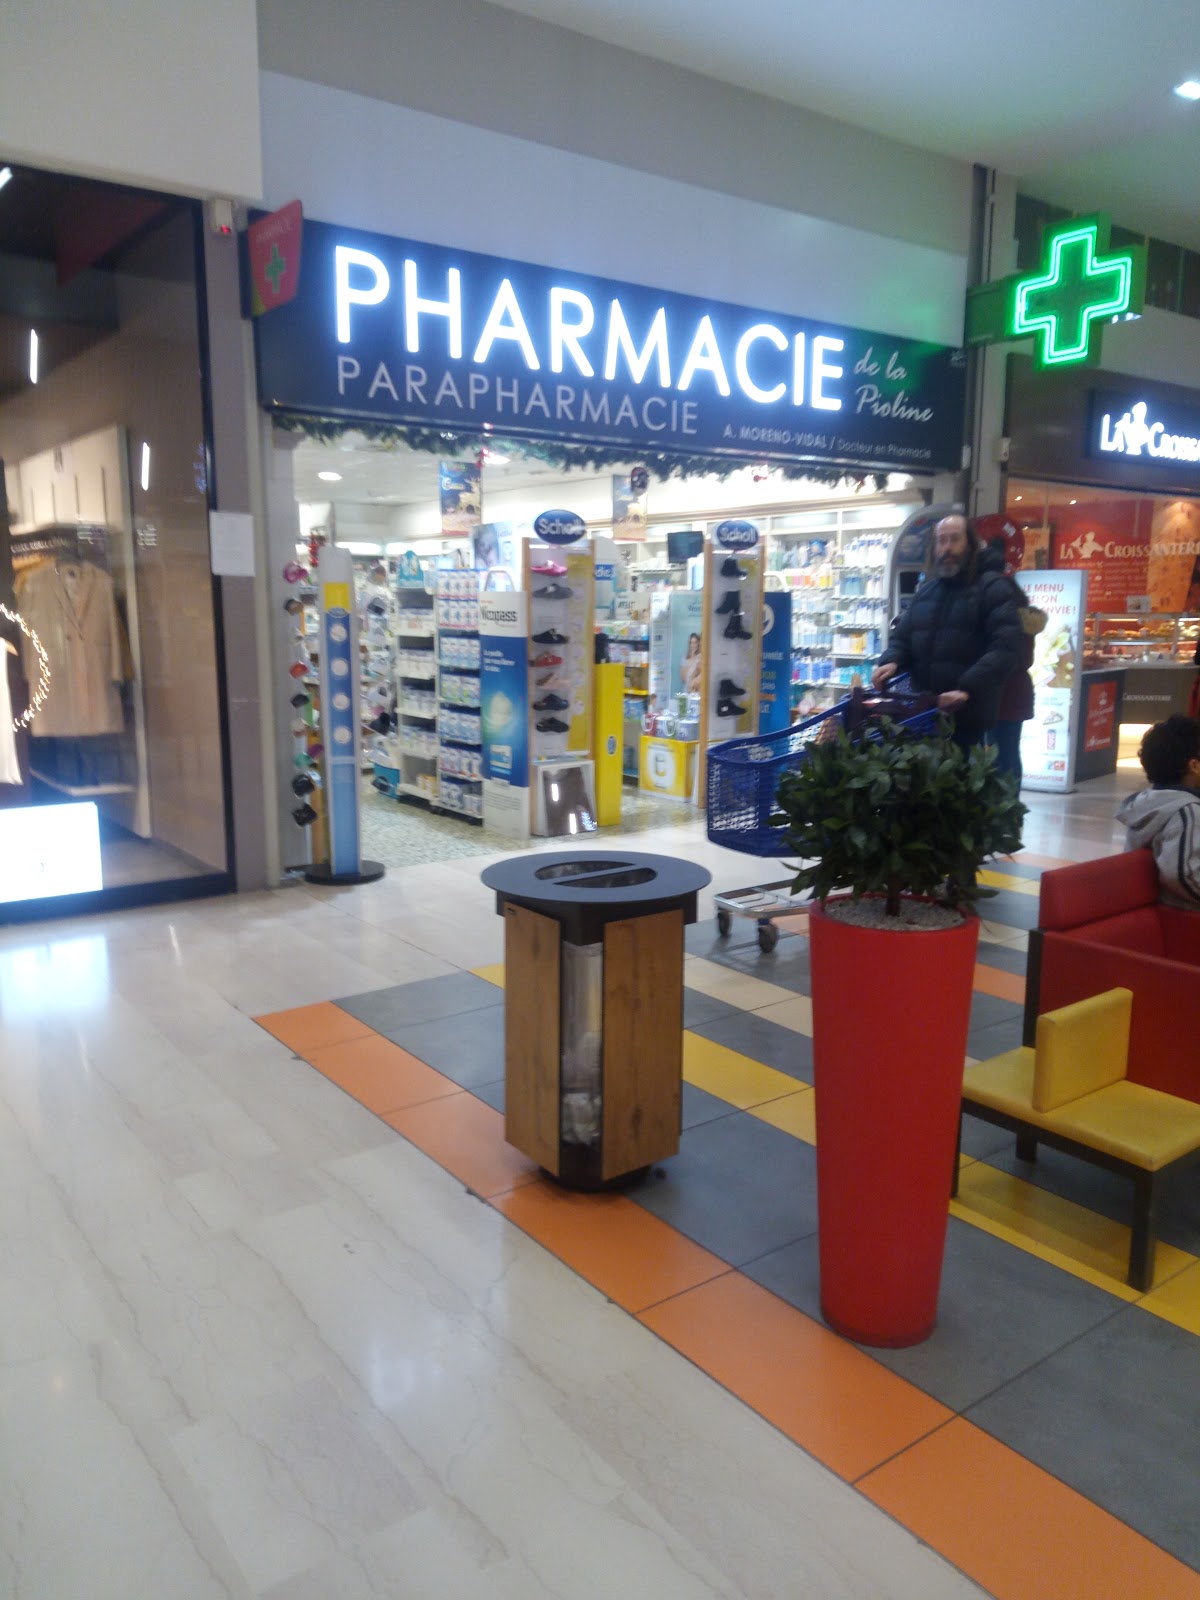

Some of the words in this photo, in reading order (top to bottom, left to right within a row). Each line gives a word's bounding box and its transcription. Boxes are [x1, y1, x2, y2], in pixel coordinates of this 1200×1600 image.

[334, 244, 845, 412] PHARMACIE
[854, 346, 880, 376] de
[886, 350, 907, 380] la
[337, 354, 699, 435] PARAPHARMACIE
[855, 383, 934, 422] Pioline
[739, 425, 828, 449] MORENO-VIDAL
[1148, 421, 1200, 461] CROISS
[539, 518, 583, 536] Scholl
[720, 527, 756, 543] Scholl
[1060, 544, 1075, 560] LA
[1034, 584, 1064, 593] MENU
